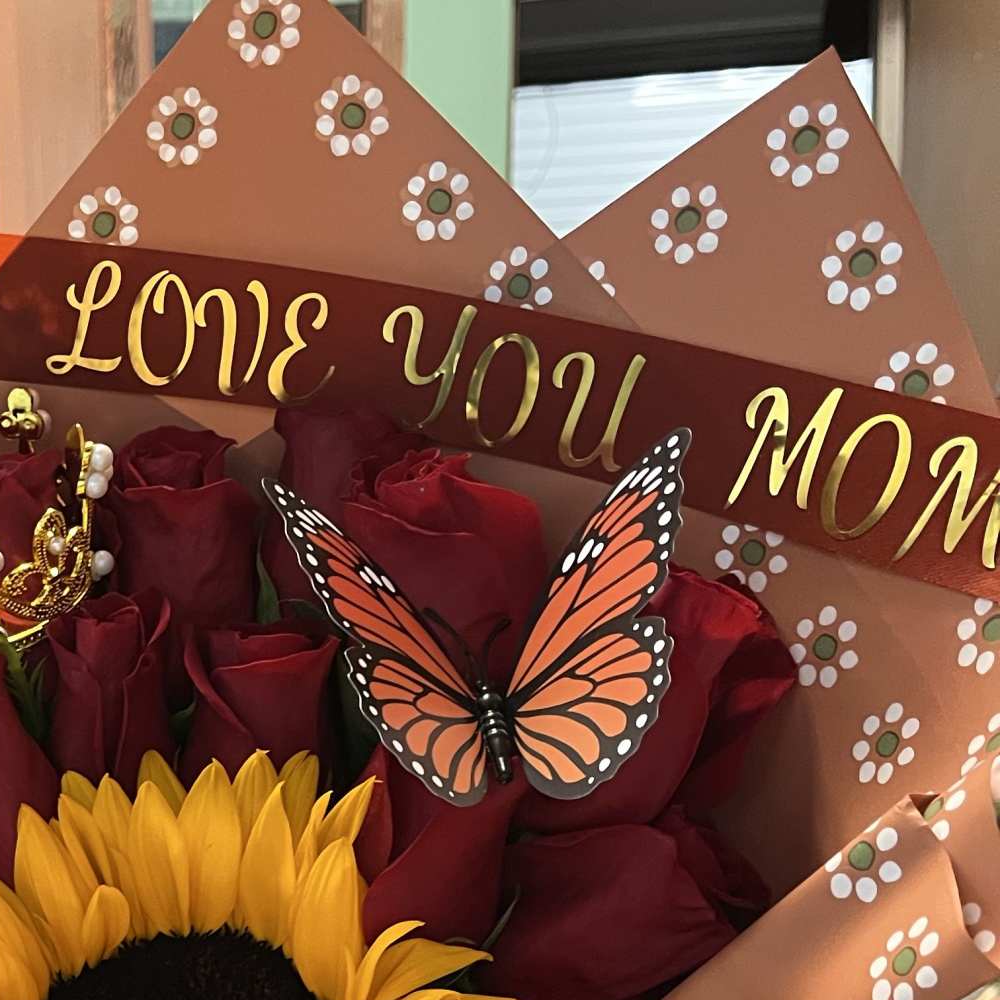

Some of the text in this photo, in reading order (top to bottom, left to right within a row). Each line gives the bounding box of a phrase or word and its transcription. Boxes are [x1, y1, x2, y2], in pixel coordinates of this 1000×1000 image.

[45, 260, 336, 401] LOVE
[382, 304, 647, 472] YOU
[724, 386, 1000, 570] MOM
